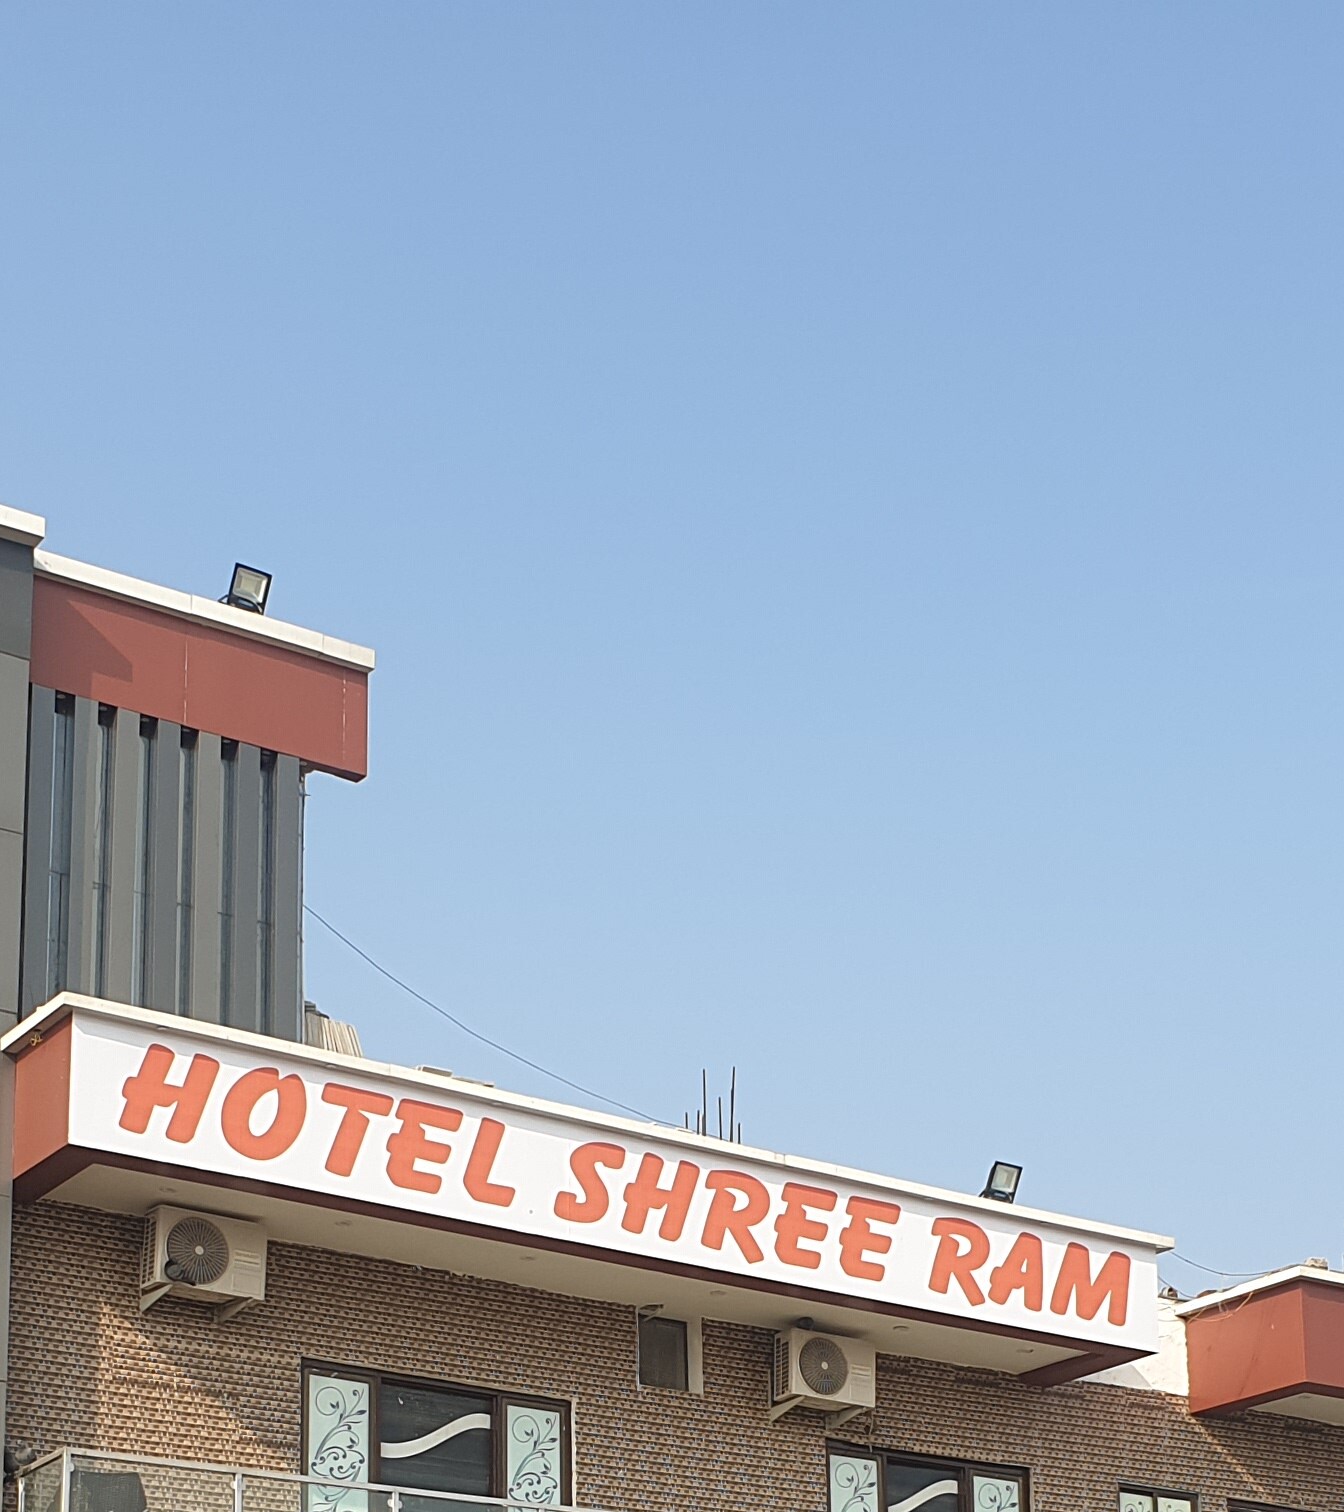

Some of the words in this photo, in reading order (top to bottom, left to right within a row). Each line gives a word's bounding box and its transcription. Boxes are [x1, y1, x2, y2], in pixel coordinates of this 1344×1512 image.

[119, 1043, 516, 1207] HOTEL
[554, 1140, 901, 1282] SHREE
[929, 1217, 1131, 1326] RAM
